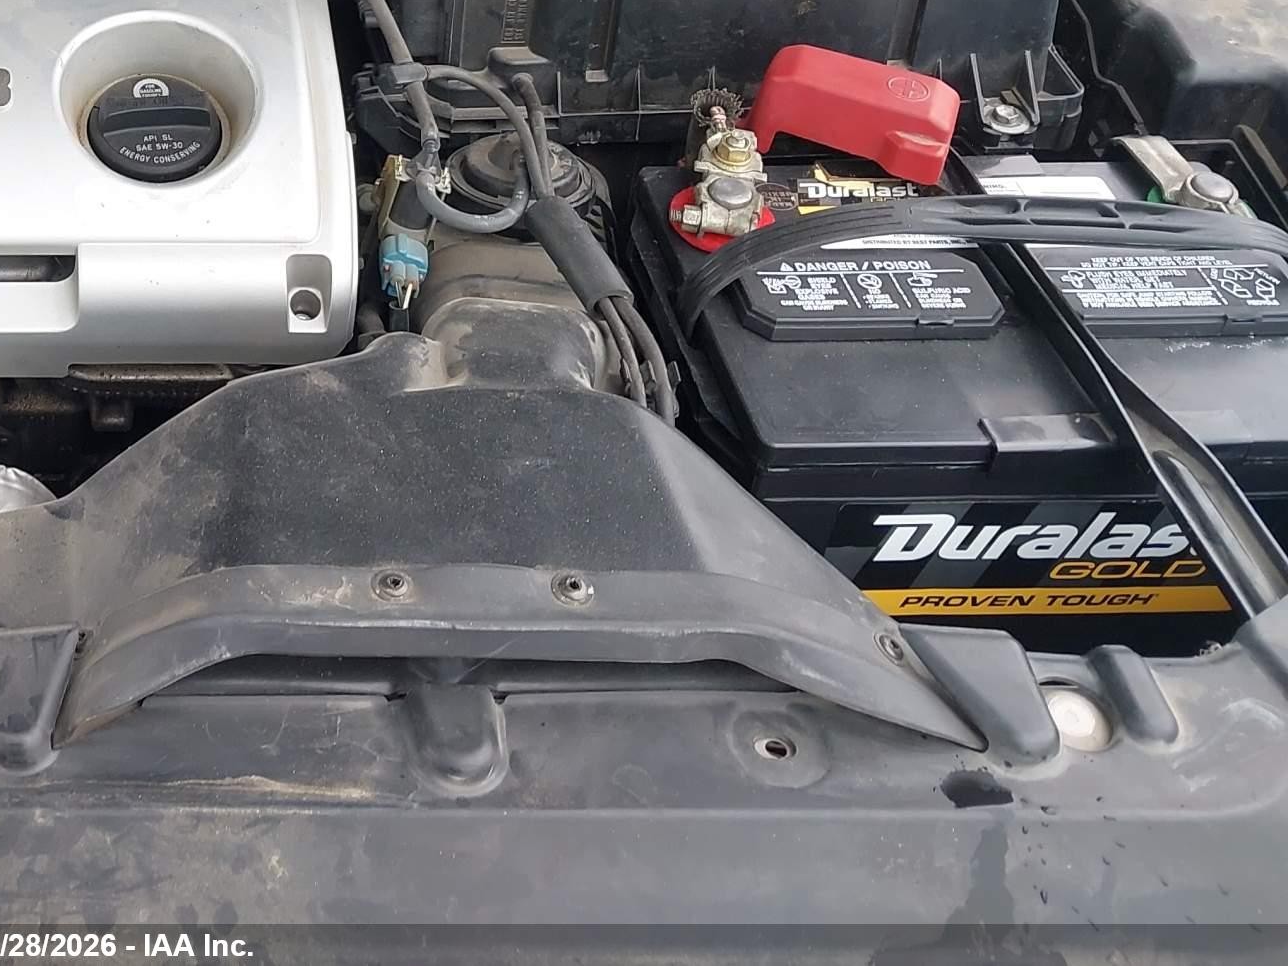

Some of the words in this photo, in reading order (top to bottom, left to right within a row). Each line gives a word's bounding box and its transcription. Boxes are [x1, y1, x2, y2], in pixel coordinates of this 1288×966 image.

[143, 135, 158, 143] API
[162, 134, 173, 142] SL
[119, 146, 151, 163] ENERGY
[153, 141, 201, 164] CONSERVING
[136, 143, 153, 152] SAE
[156, 141, 183, 151] 5W-30
[800, 182, 919, 198] Duralast
[793, 262, 859, 272] DANGER
[862, 260, 869, 271] /
[872, 260, 931, 270] POISON
[873, 512, 1199, 562] Duralas
[1049, 559, 1208, 580] GOLD
[899, 594, 1039, 608] PROVEN
